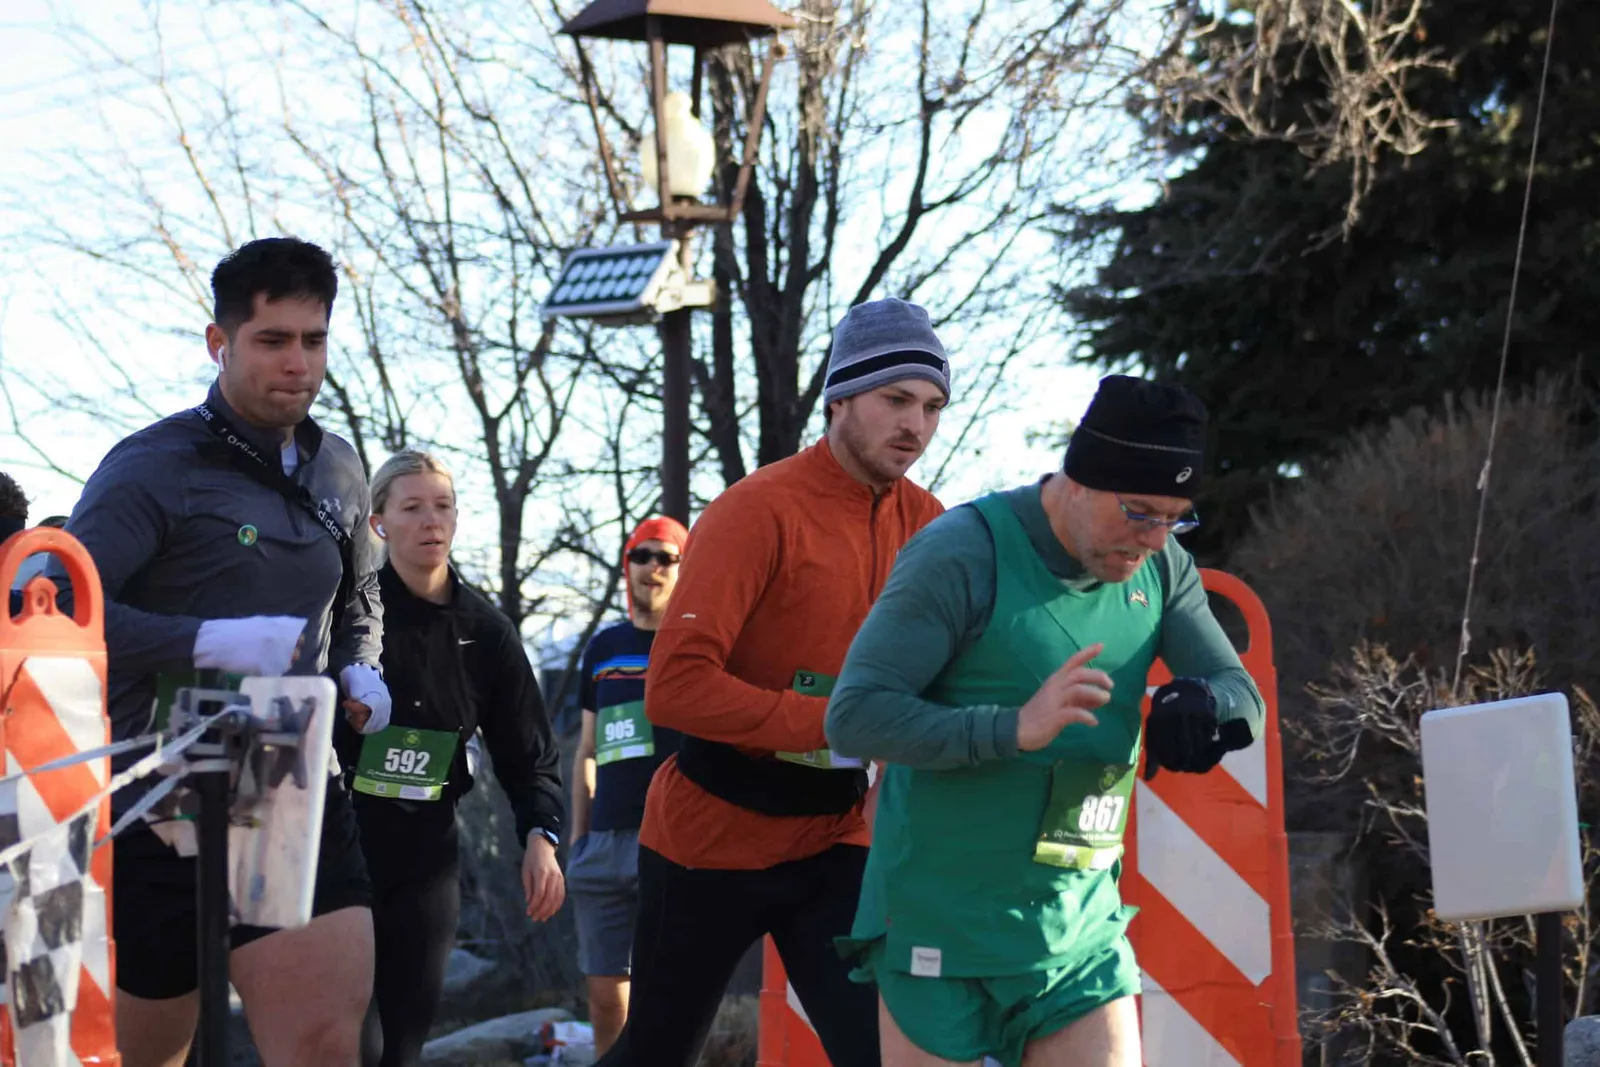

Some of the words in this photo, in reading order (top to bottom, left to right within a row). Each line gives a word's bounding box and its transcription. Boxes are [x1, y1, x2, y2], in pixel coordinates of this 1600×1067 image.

[604, 718, 635, 742] 905
[384, 747, 430, 775] 592
[1078, 795, 1125, 832] 867
